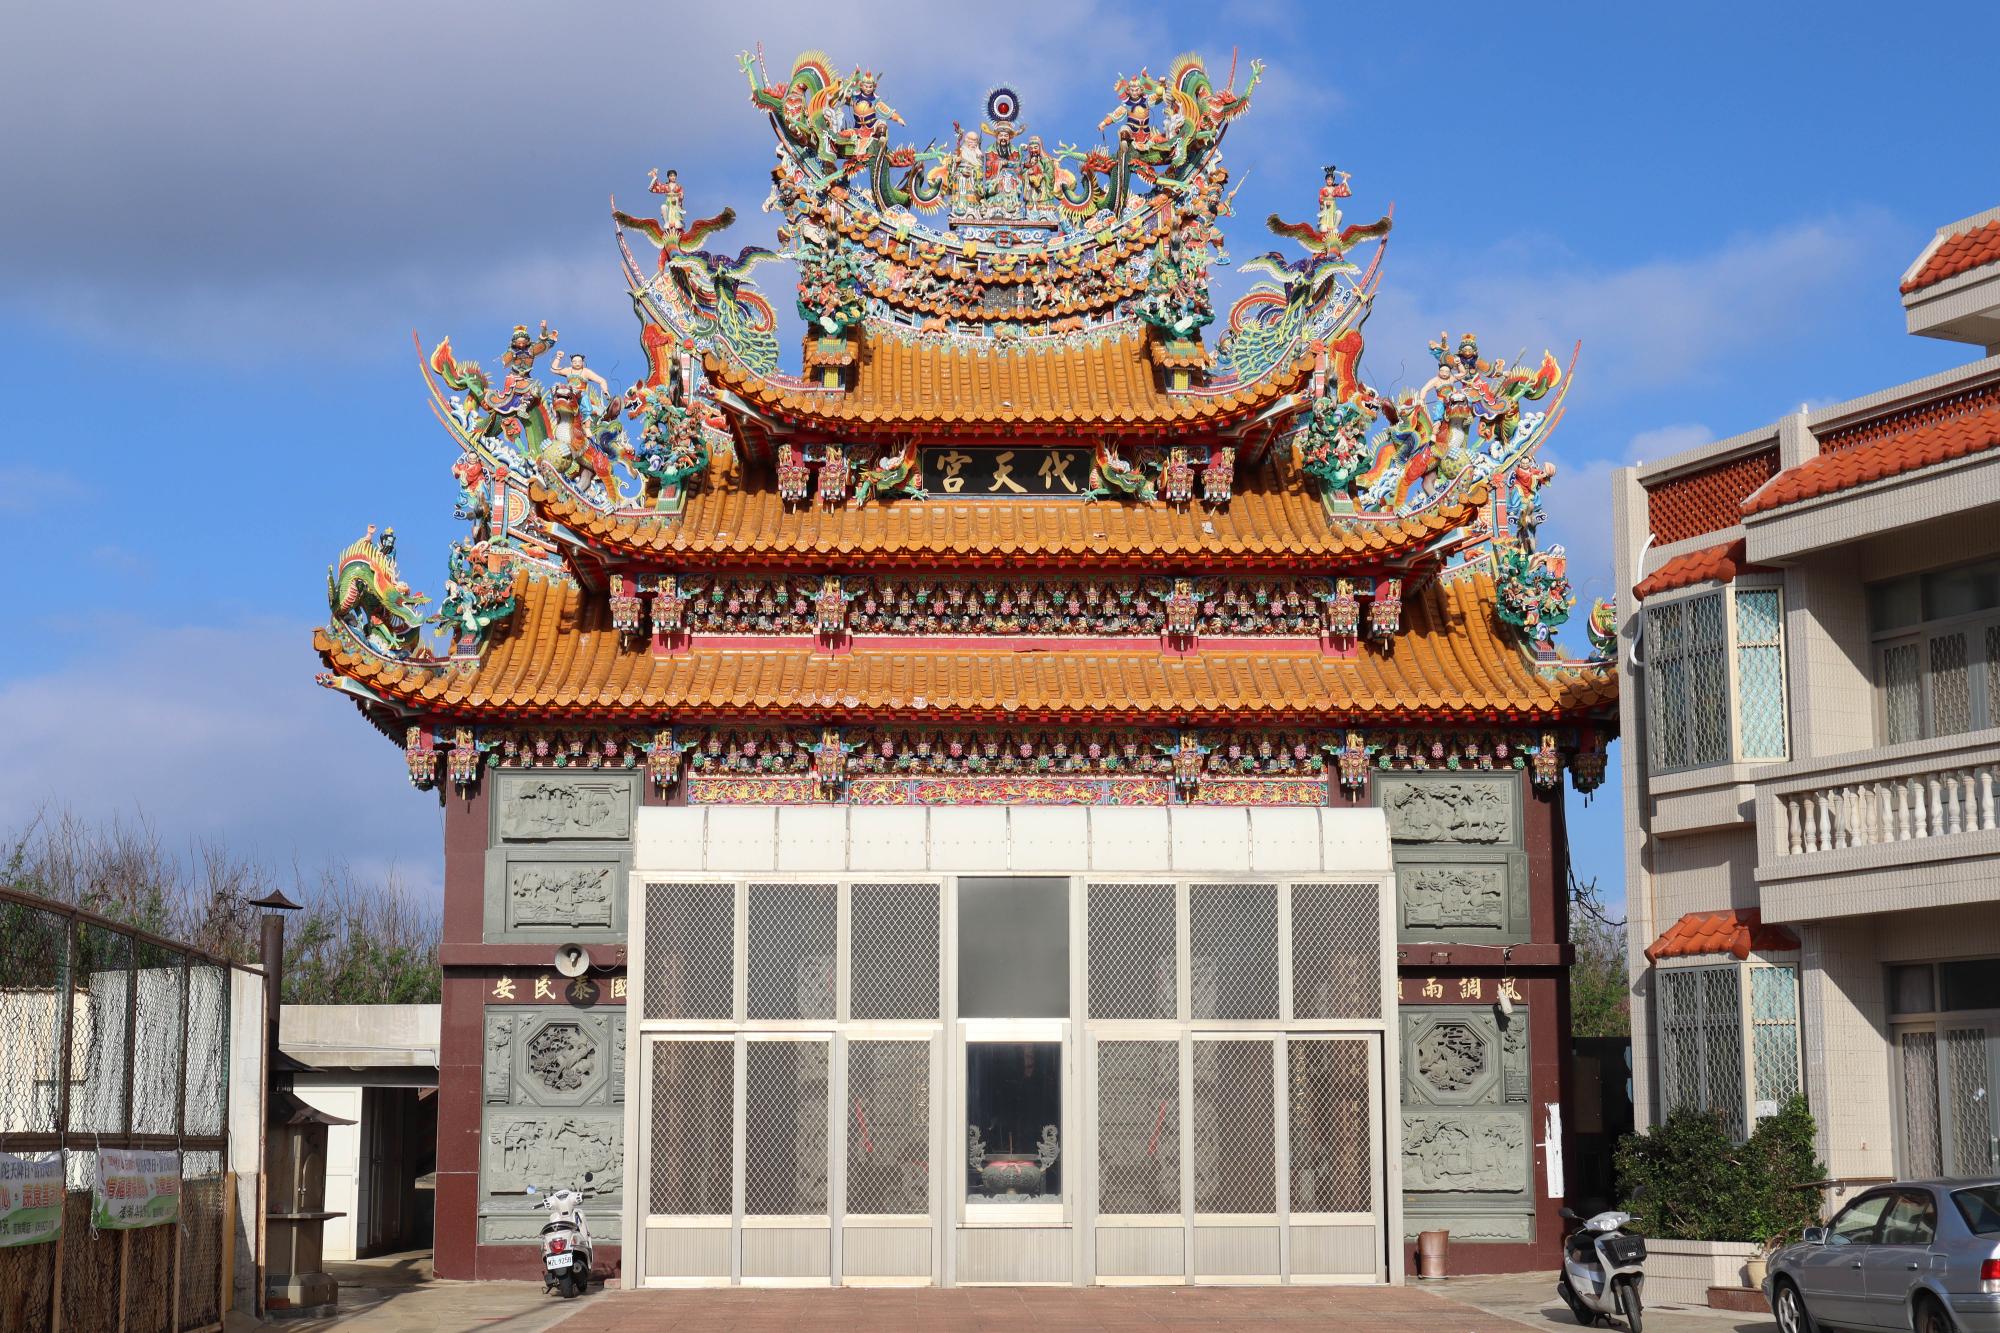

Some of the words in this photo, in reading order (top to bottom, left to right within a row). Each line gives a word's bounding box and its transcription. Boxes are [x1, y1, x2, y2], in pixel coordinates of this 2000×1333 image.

[936, 450, 1078, 493] 代天宮
[1397, 975, 1522, 1001] 風調雨
